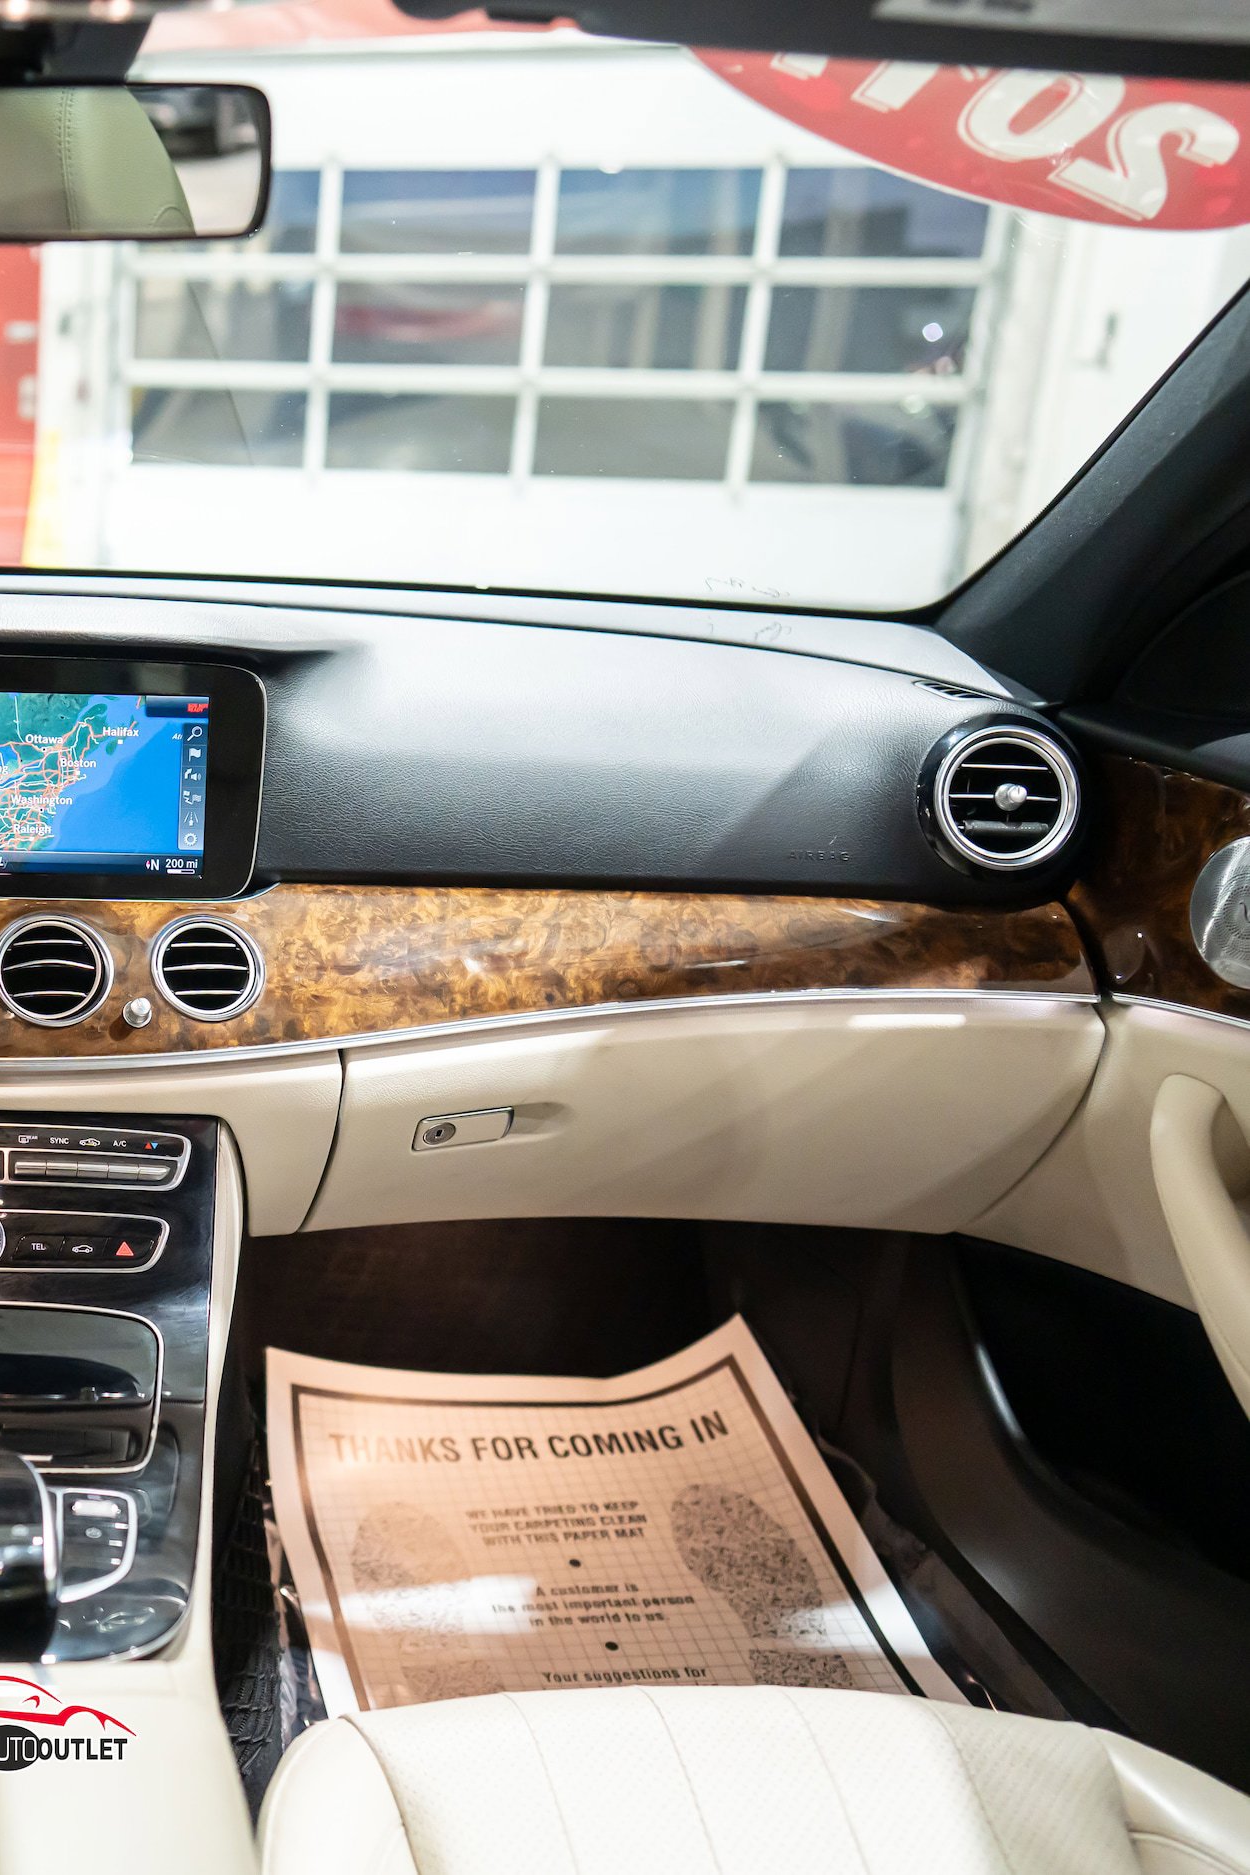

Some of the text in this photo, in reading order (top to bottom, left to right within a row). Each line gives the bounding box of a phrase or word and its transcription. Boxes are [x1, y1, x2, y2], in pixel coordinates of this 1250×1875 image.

[103, 727, 139, 737] Halifax
[25, 734, 63, 744] Ottawa
[60, 759, 96, 768] Boston
[11, 795, 72, 806] Washington
[14, 824, 52, 835] Raleigh
[150, 859, 159, 870] N
[165, 859, 198, 868] 200 mi
[50, 1137, 70, 1145] SYNC
[31, 1243, 47, 1251] TEL
[329, 1410, 729, 1463] THANKS FOR COMING IN
[466, 1501, 638, 1519] WE HAVE TRIED TO KEEP
[469, 1514, 647, 1533] YOUR CARPETING CLEAN
[483, 1527, 645, 1546] WITH THIS PAPER MAT
[536, 1584, 639, 1597] A customer is
[492, 1596, 695, 1614] the most important person
[530, 1618, 544, 1627] in
[548, 1615, 573, 1626] the
[578, 1612, 621, 1624] world
[625, 1612, 641, 1622] to
[542, 1667, 707, 1685] Your suggestions for
